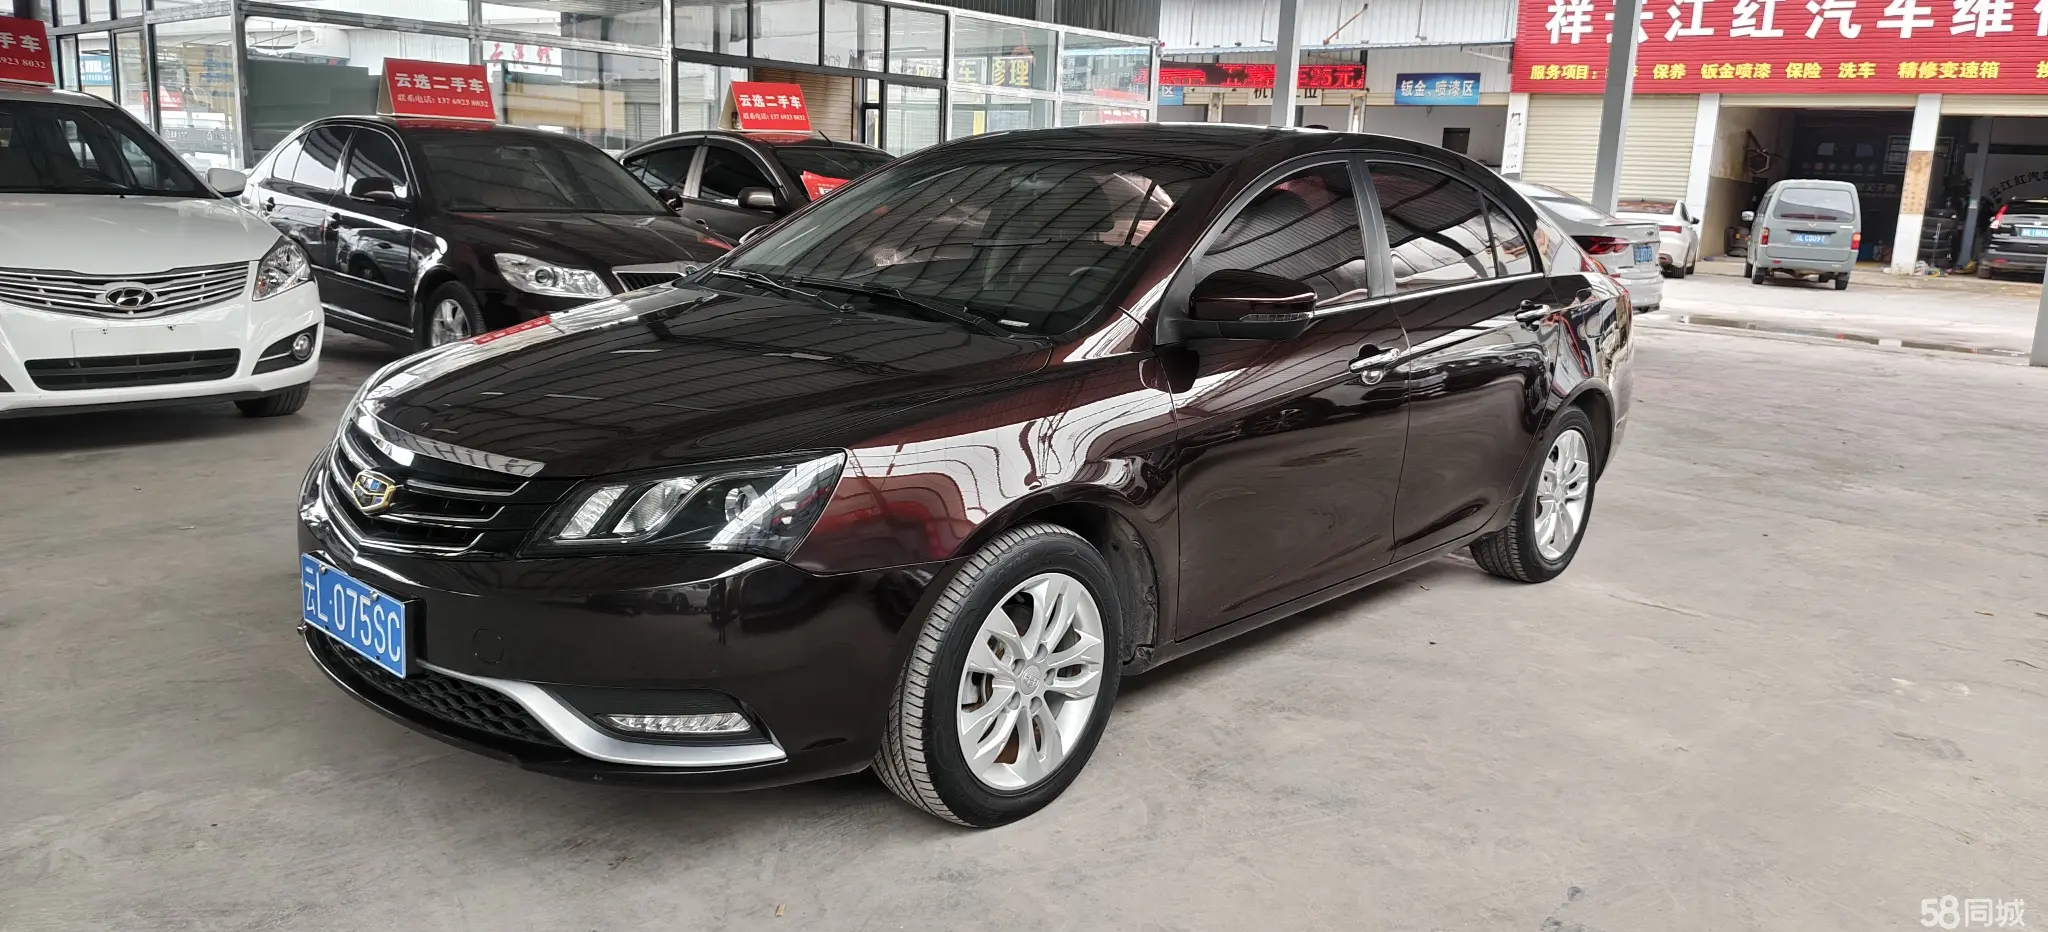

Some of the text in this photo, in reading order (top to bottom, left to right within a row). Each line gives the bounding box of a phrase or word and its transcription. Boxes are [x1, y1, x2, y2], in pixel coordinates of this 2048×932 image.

[22, 58, 46, 69] 8032
[1652, 64, 1686, 79] 保养
[1701, 63, 1772, 79] 钣金喷漆
[1785, 62, 1823, 78] 保险
[1837, 62, 1876, 78] 洗车
[1897, 61, 2000, 79] 精修变速箱
[394, 72, 485, 94] 云选二手车
[1401, 80, 1474, 97] 钣金、喷漆区
[437, 97, 450, 105] 137
[739, 94, 802, 109] 云选二手车
